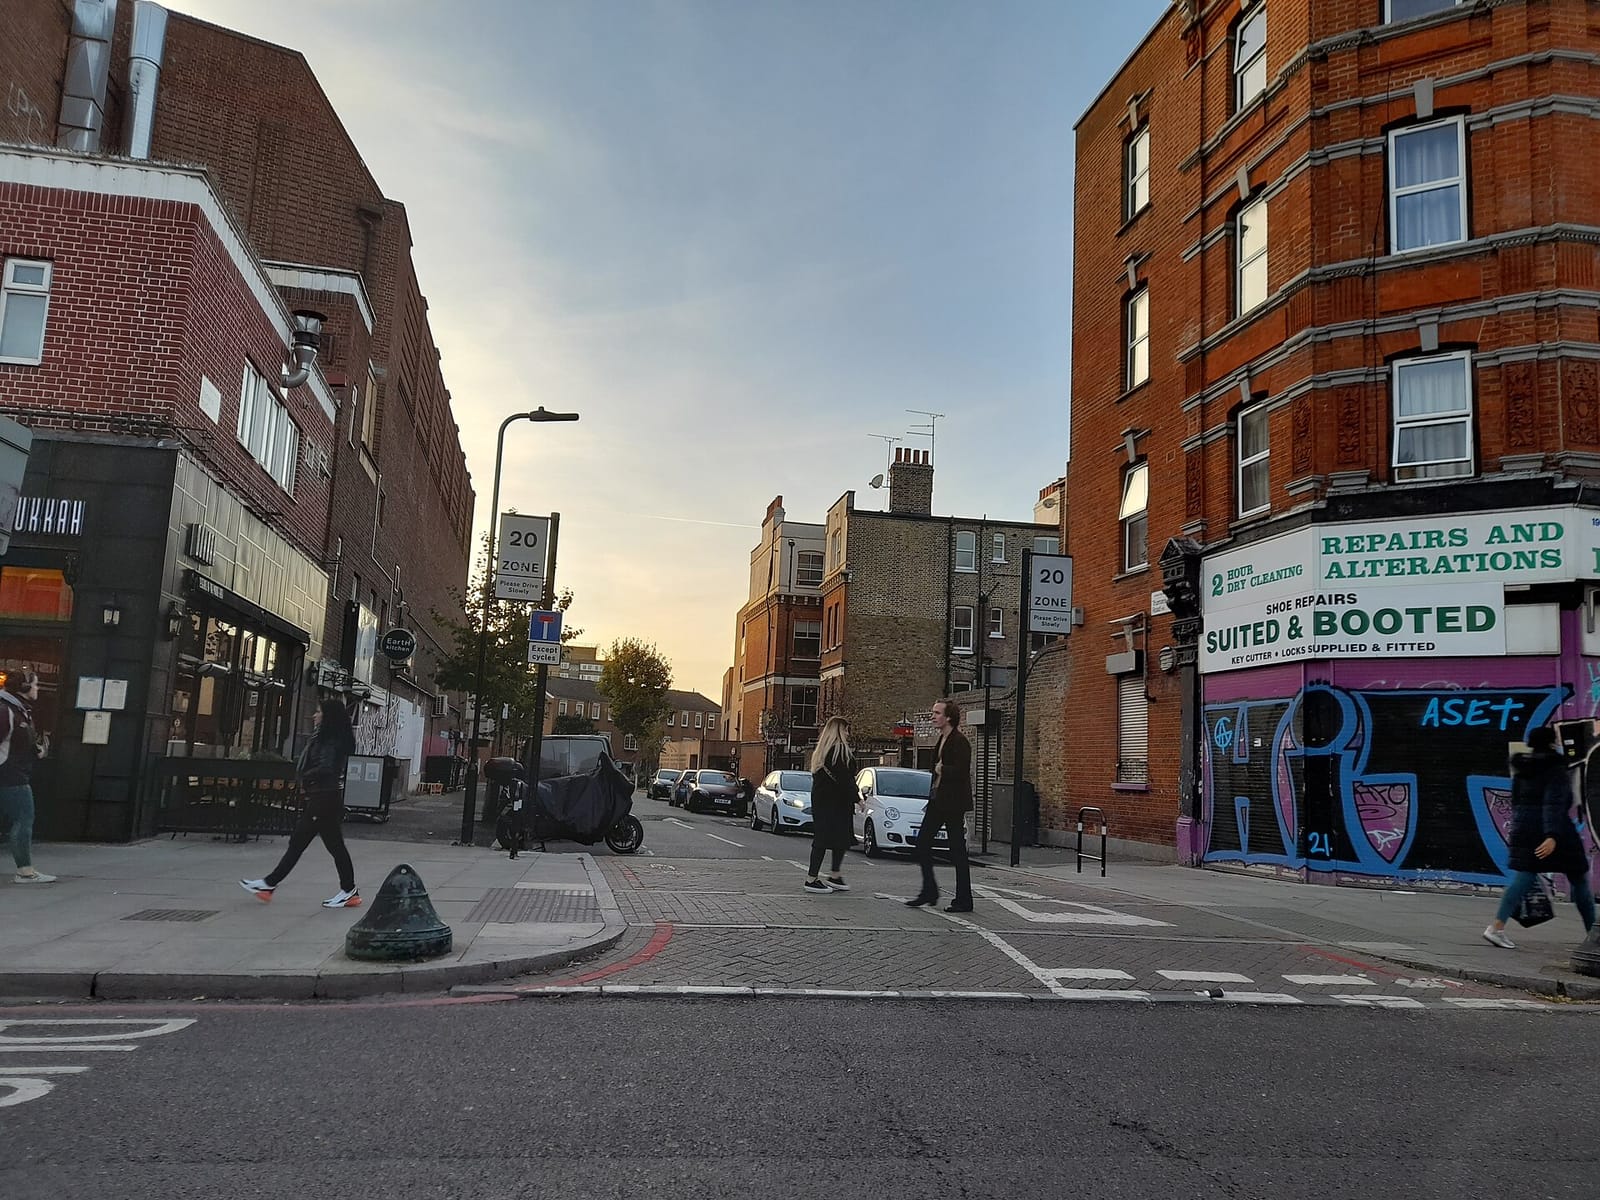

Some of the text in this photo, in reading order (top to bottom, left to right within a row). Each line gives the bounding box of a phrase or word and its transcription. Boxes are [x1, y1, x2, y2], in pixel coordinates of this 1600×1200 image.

[14, 496, 86, 536] UKKAH
[509, 530, 538, 548] 20
[1321, 522, 1564, 555] REPAIRS AND
[502, 560, 540, 573] ZONE
[1227, 564, 1254, 581] HOUR
[1324, 548, 1563, 580] ALTERATIONS
[1040, 568, 1064, 585] 20
[1211, 573, 1225, 597] 2
[1226, 564, 1304, 593] DRY CLEANING
[508, 587, 530, 595] Slowly
[1034, 596, 1067, 608] ZONE
[1266, 593, 1358, 615] SHOE REPAIRS
[1206, 605, 1497, 654] SUITED & BOOTED
[531, 644, 558, 654] Except
[531, 653, 556, 662] cycles
[1231, 642, 1436, 665] KEY CUTTER LOCKS SUPPLIED & FITTED
